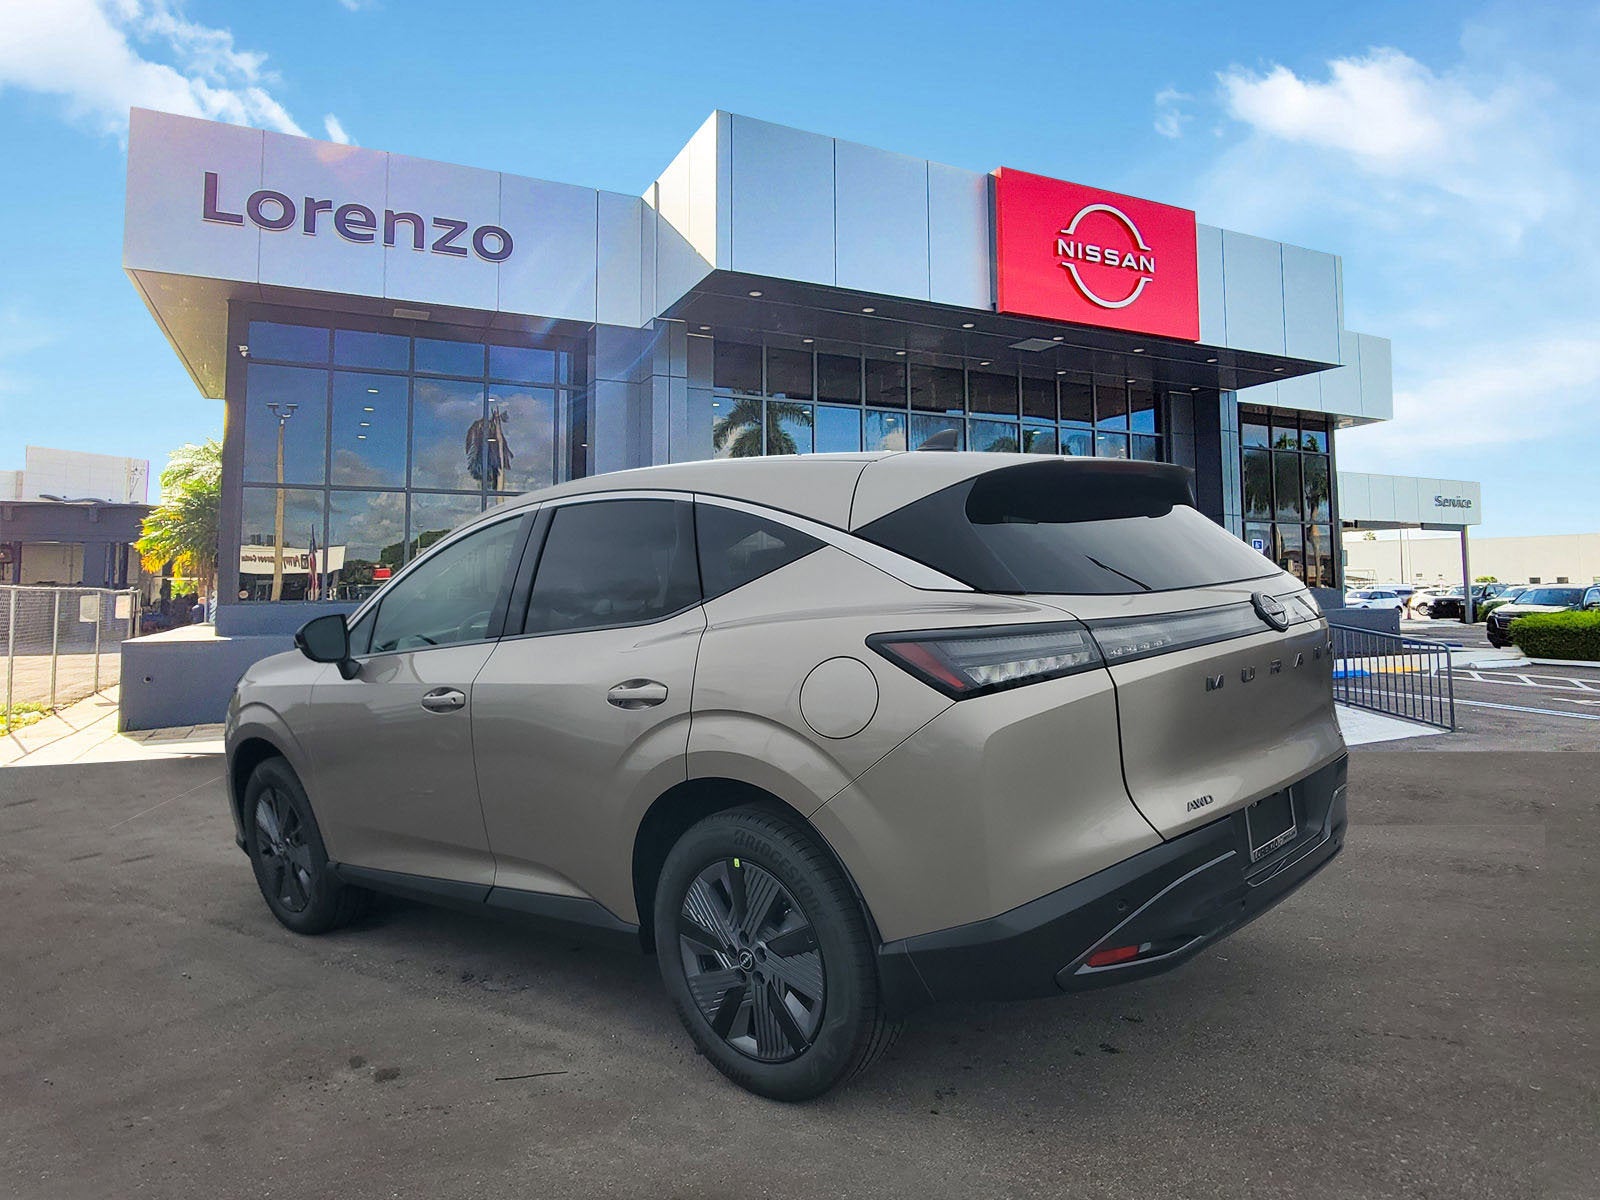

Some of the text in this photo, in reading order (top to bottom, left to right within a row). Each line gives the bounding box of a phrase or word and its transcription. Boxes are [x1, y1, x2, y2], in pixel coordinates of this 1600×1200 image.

[203, 170, 515, 263] Lorenzo
[1057, 238, 1155, 273] NISSAN
[1434, 495, 1472, 509] Service
[1186, 794, 1215, 812] AWD
